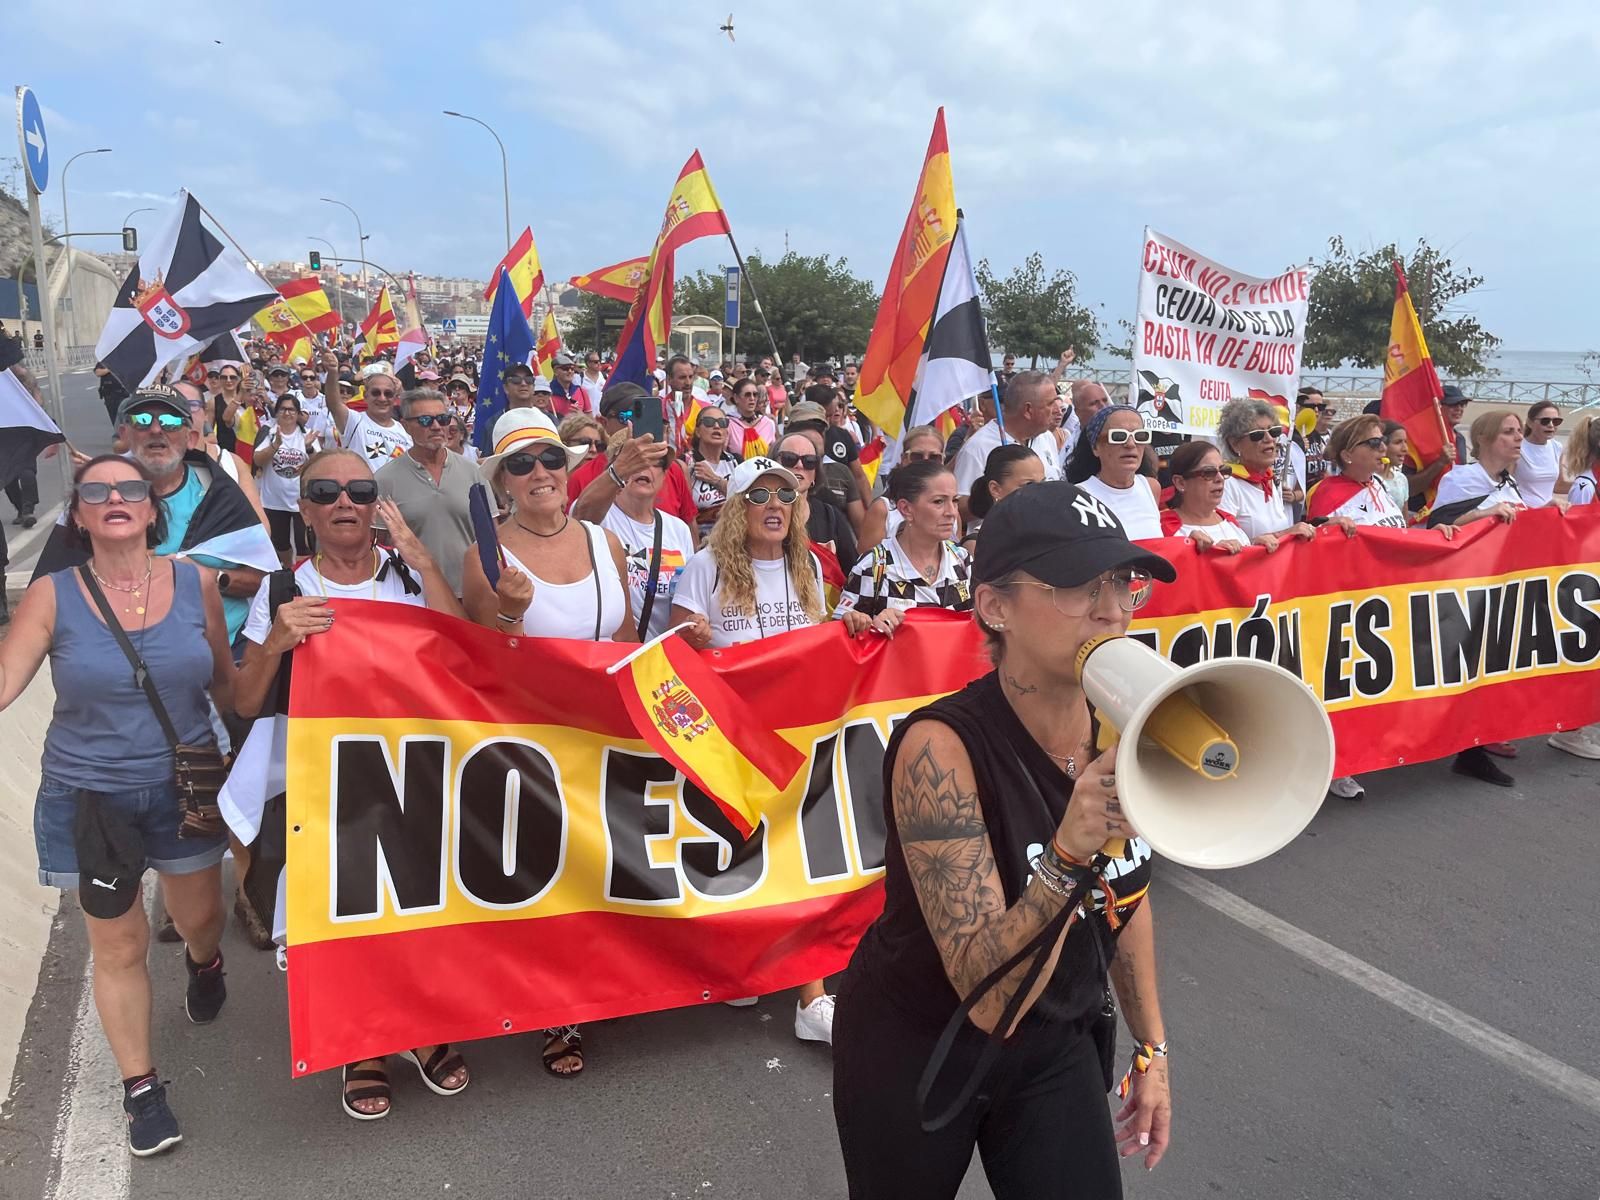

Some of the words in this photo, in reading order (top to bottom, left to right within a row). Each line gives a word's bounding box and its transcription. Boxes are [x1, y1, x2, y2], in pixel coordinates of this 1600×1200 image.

[1143, 239, 1196, 284] CEUTA
[1198, 266, 1231, 299] NO
[1249, 271, 1309, 305] VENDE
[1156, 284, 1216, 327] CEUTA
[1220, 308, 1246, 333] NO
[1245, 310, 1271, 336] SE
[1269, 309, 1295, 338] DA
[1144, 321, 1192, 362] BASTA
[1195, 331, 1218, 366] YA
[1217, 337, 1250, 369] DE
[1244, 341, 1295, 376] BULOS
[1200, 379, 1232, 401] CEUTA
[754, 458, 773, 471] NY
[698, 493, 711, 502] NO
[1071, 494, 1117, 529] NY
[774, 602, 785, 613] SE
[723, 618, 752, 631] CEUTA
[756, 616, 768, 629] SE
[329, 734, 568, 922] NO
[602, 745, 769, 907] ES
[1323, 594, 1396, 703] ES
[1408, 572, 1600, 690] INVAS
